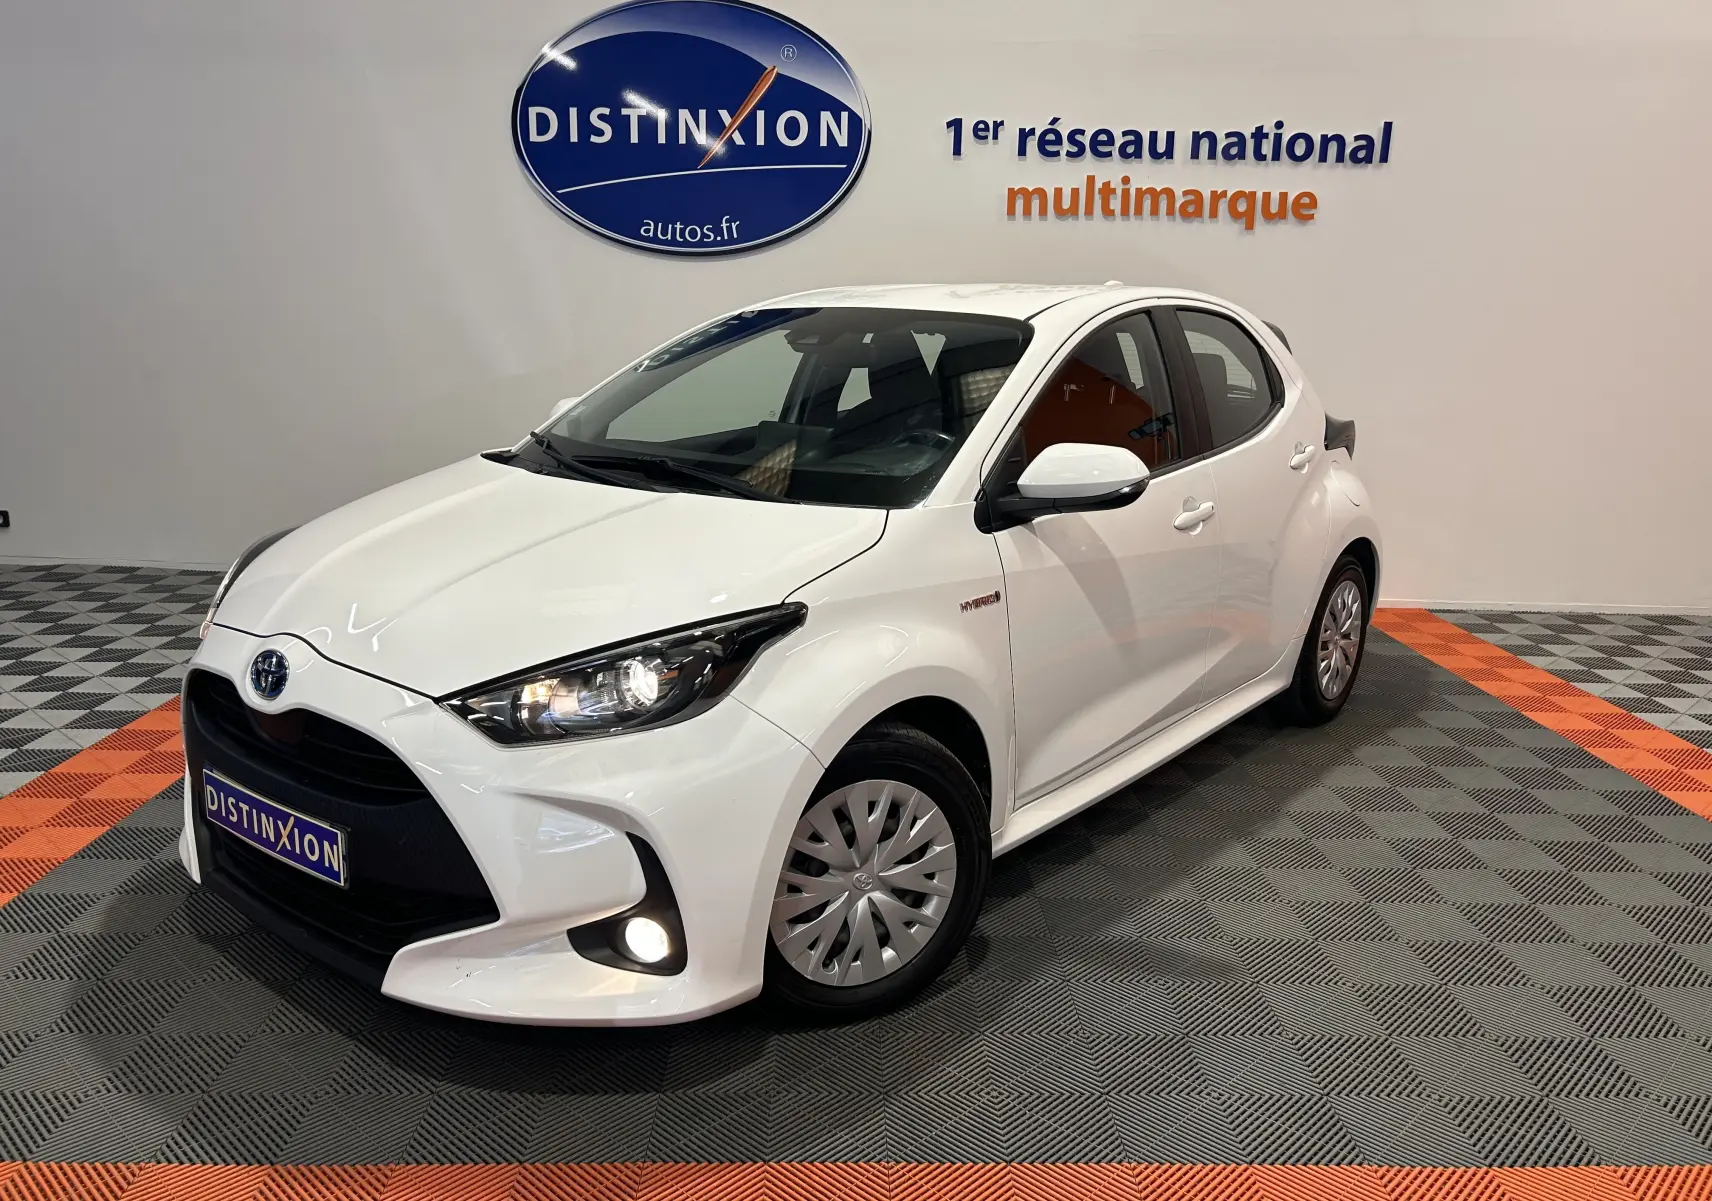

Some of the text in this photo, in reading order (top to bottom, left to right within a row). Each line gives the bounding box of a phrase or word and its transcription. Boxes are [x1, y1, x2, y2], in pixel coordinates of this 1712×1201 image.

[528, 102, 848, 156] DISTINXION
[945, 117, 1393, 164] 1er réseau national
[639, 216, 741, 242] autos.fr
[1006, 175, 1318, 230] multimarque
[206, 784, 340, 872] DISTINXION
